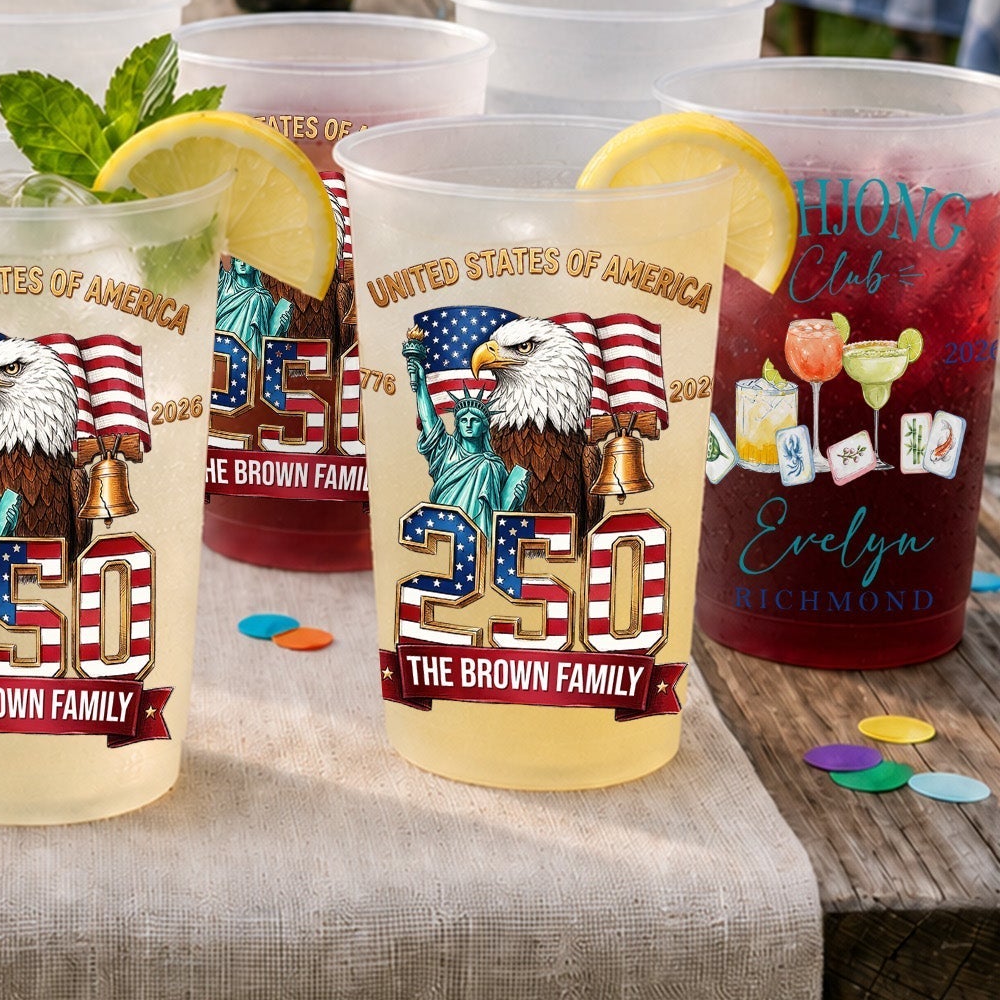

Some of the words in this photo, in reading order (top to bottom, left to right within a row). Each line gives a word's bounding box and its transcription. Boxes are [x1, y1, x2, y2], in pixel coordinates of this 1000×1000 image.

[254, 115, 319, 139] ATES
[324, 118, 352, 140] OF
[792, 178, 972, 251] HJONG
[367, 257, 459, 308] UNITED
[465, 246, 560, 281] STATES
[566, 246, 601, 278] OF
[600, 254, 714, 314] AMERICA
[789, 244, 890, 304] Club
[49, 269, 83, 299] OF
[83, 275, 192, 336] AMERICA
[359, 367, 397, 396] 776
[669, 375, 713, 403] 202
[151, 395, 204, 426] 2026
[205, 458, 229, 484] HE
[234, 459, 309, 488] BROWN
[314, 463, 369, 493] FAMI
[395, 501, 672, 655] 250
[735, 586, 935, 613] RICHMOND
[406, 655, 454, 687] THE
[462, 659, 549, 692] BROWN
[557, 662, 645, 697] FAMILY
[52, 690, 134, 723] FAMILY
